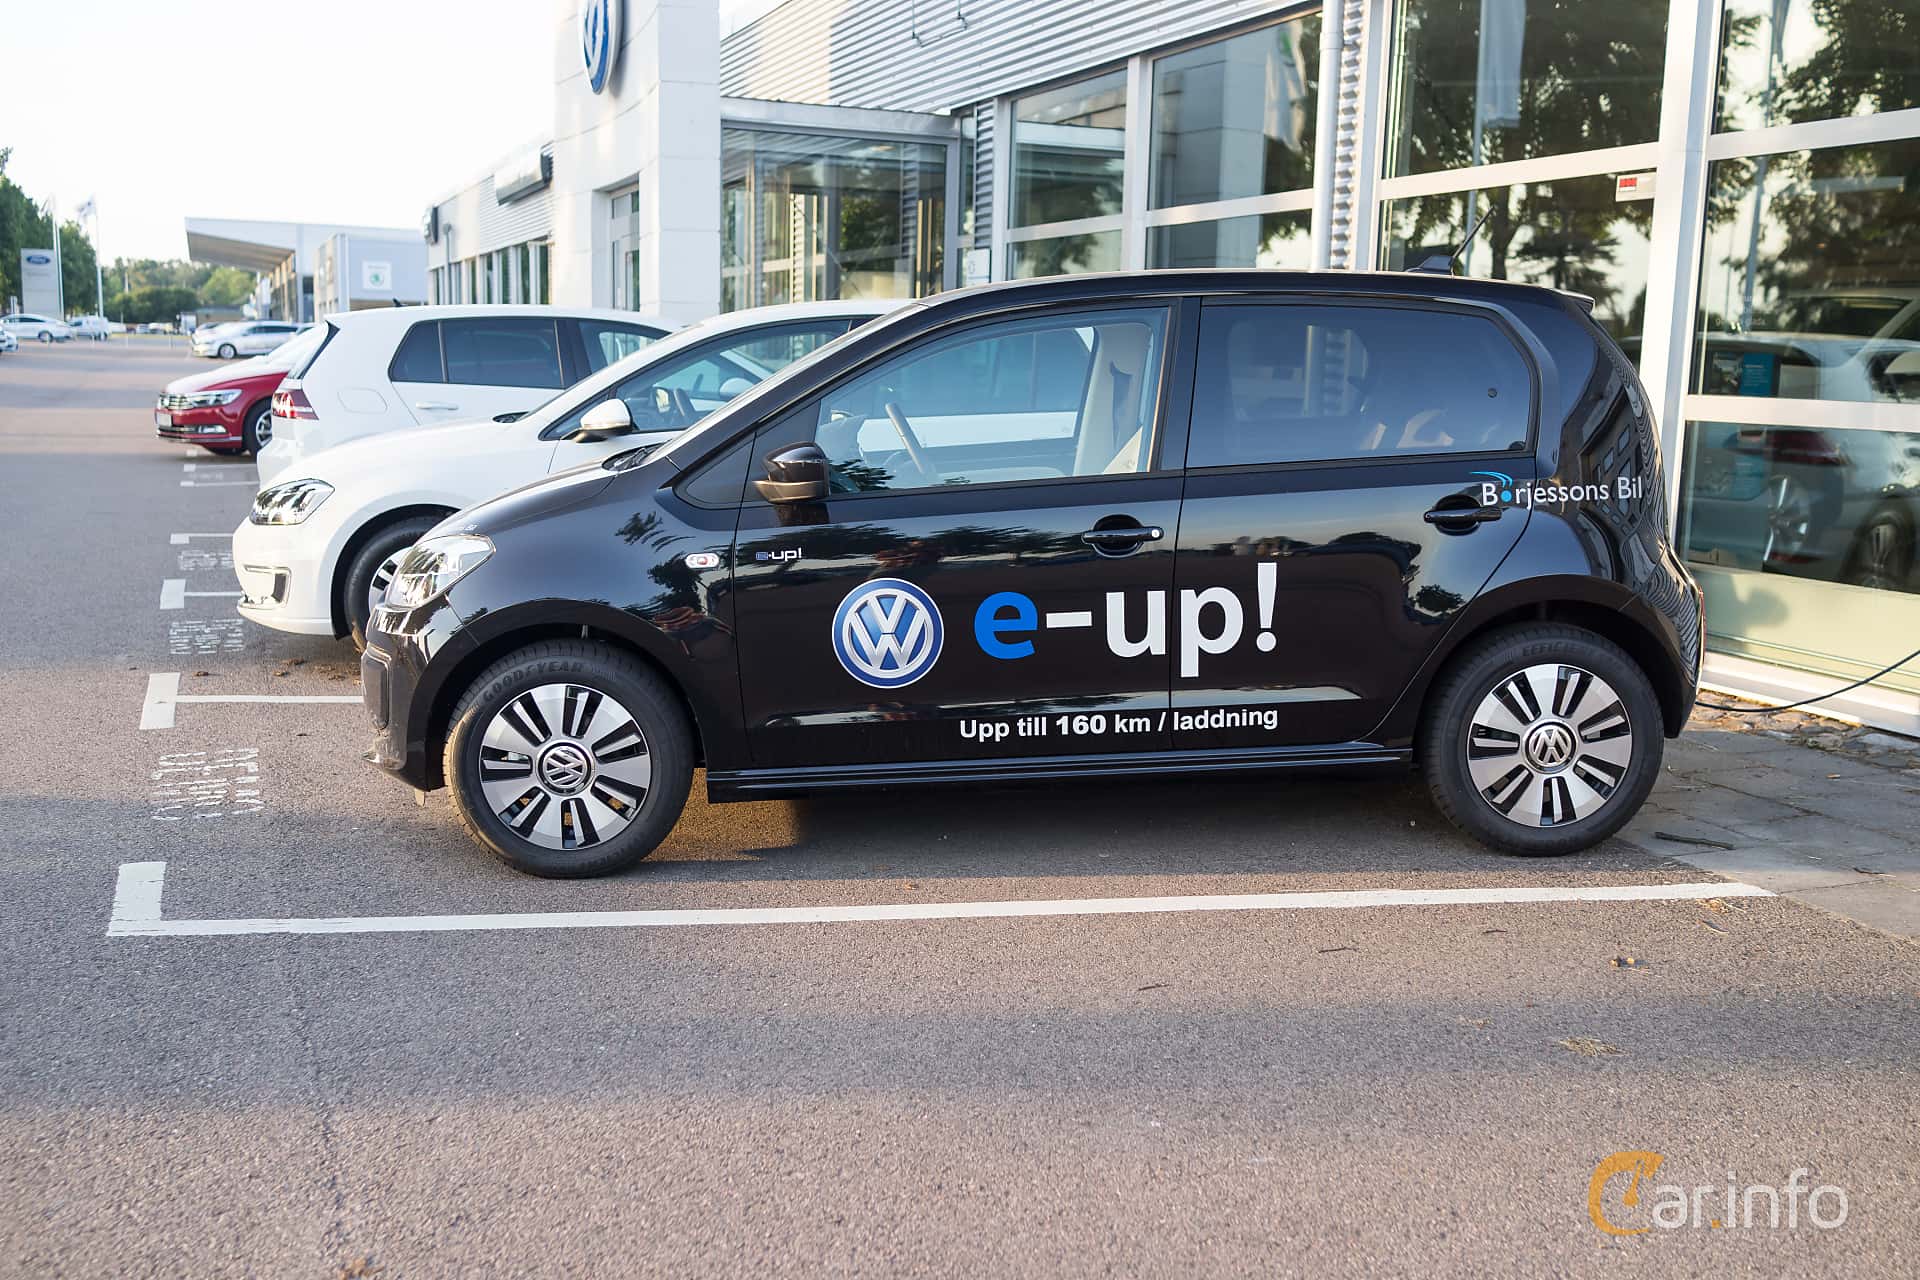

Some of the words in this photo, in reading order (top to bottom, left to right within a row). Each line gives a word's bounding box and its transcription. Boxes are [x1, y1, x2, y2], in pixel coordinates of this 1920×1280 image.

[1617, 476, 1643, 500] Bil
[974, 562, 1277, 678] e-up!
[959, 719, 1010, 742] Upp
[1016, 717, 1047, 737] till
[1056, 714, 1106, 735] 160
[1115, 714, 1151, 734] km
[1158, 712, 1167, 732] /
[1173, 708, 1278, 731] laddning
